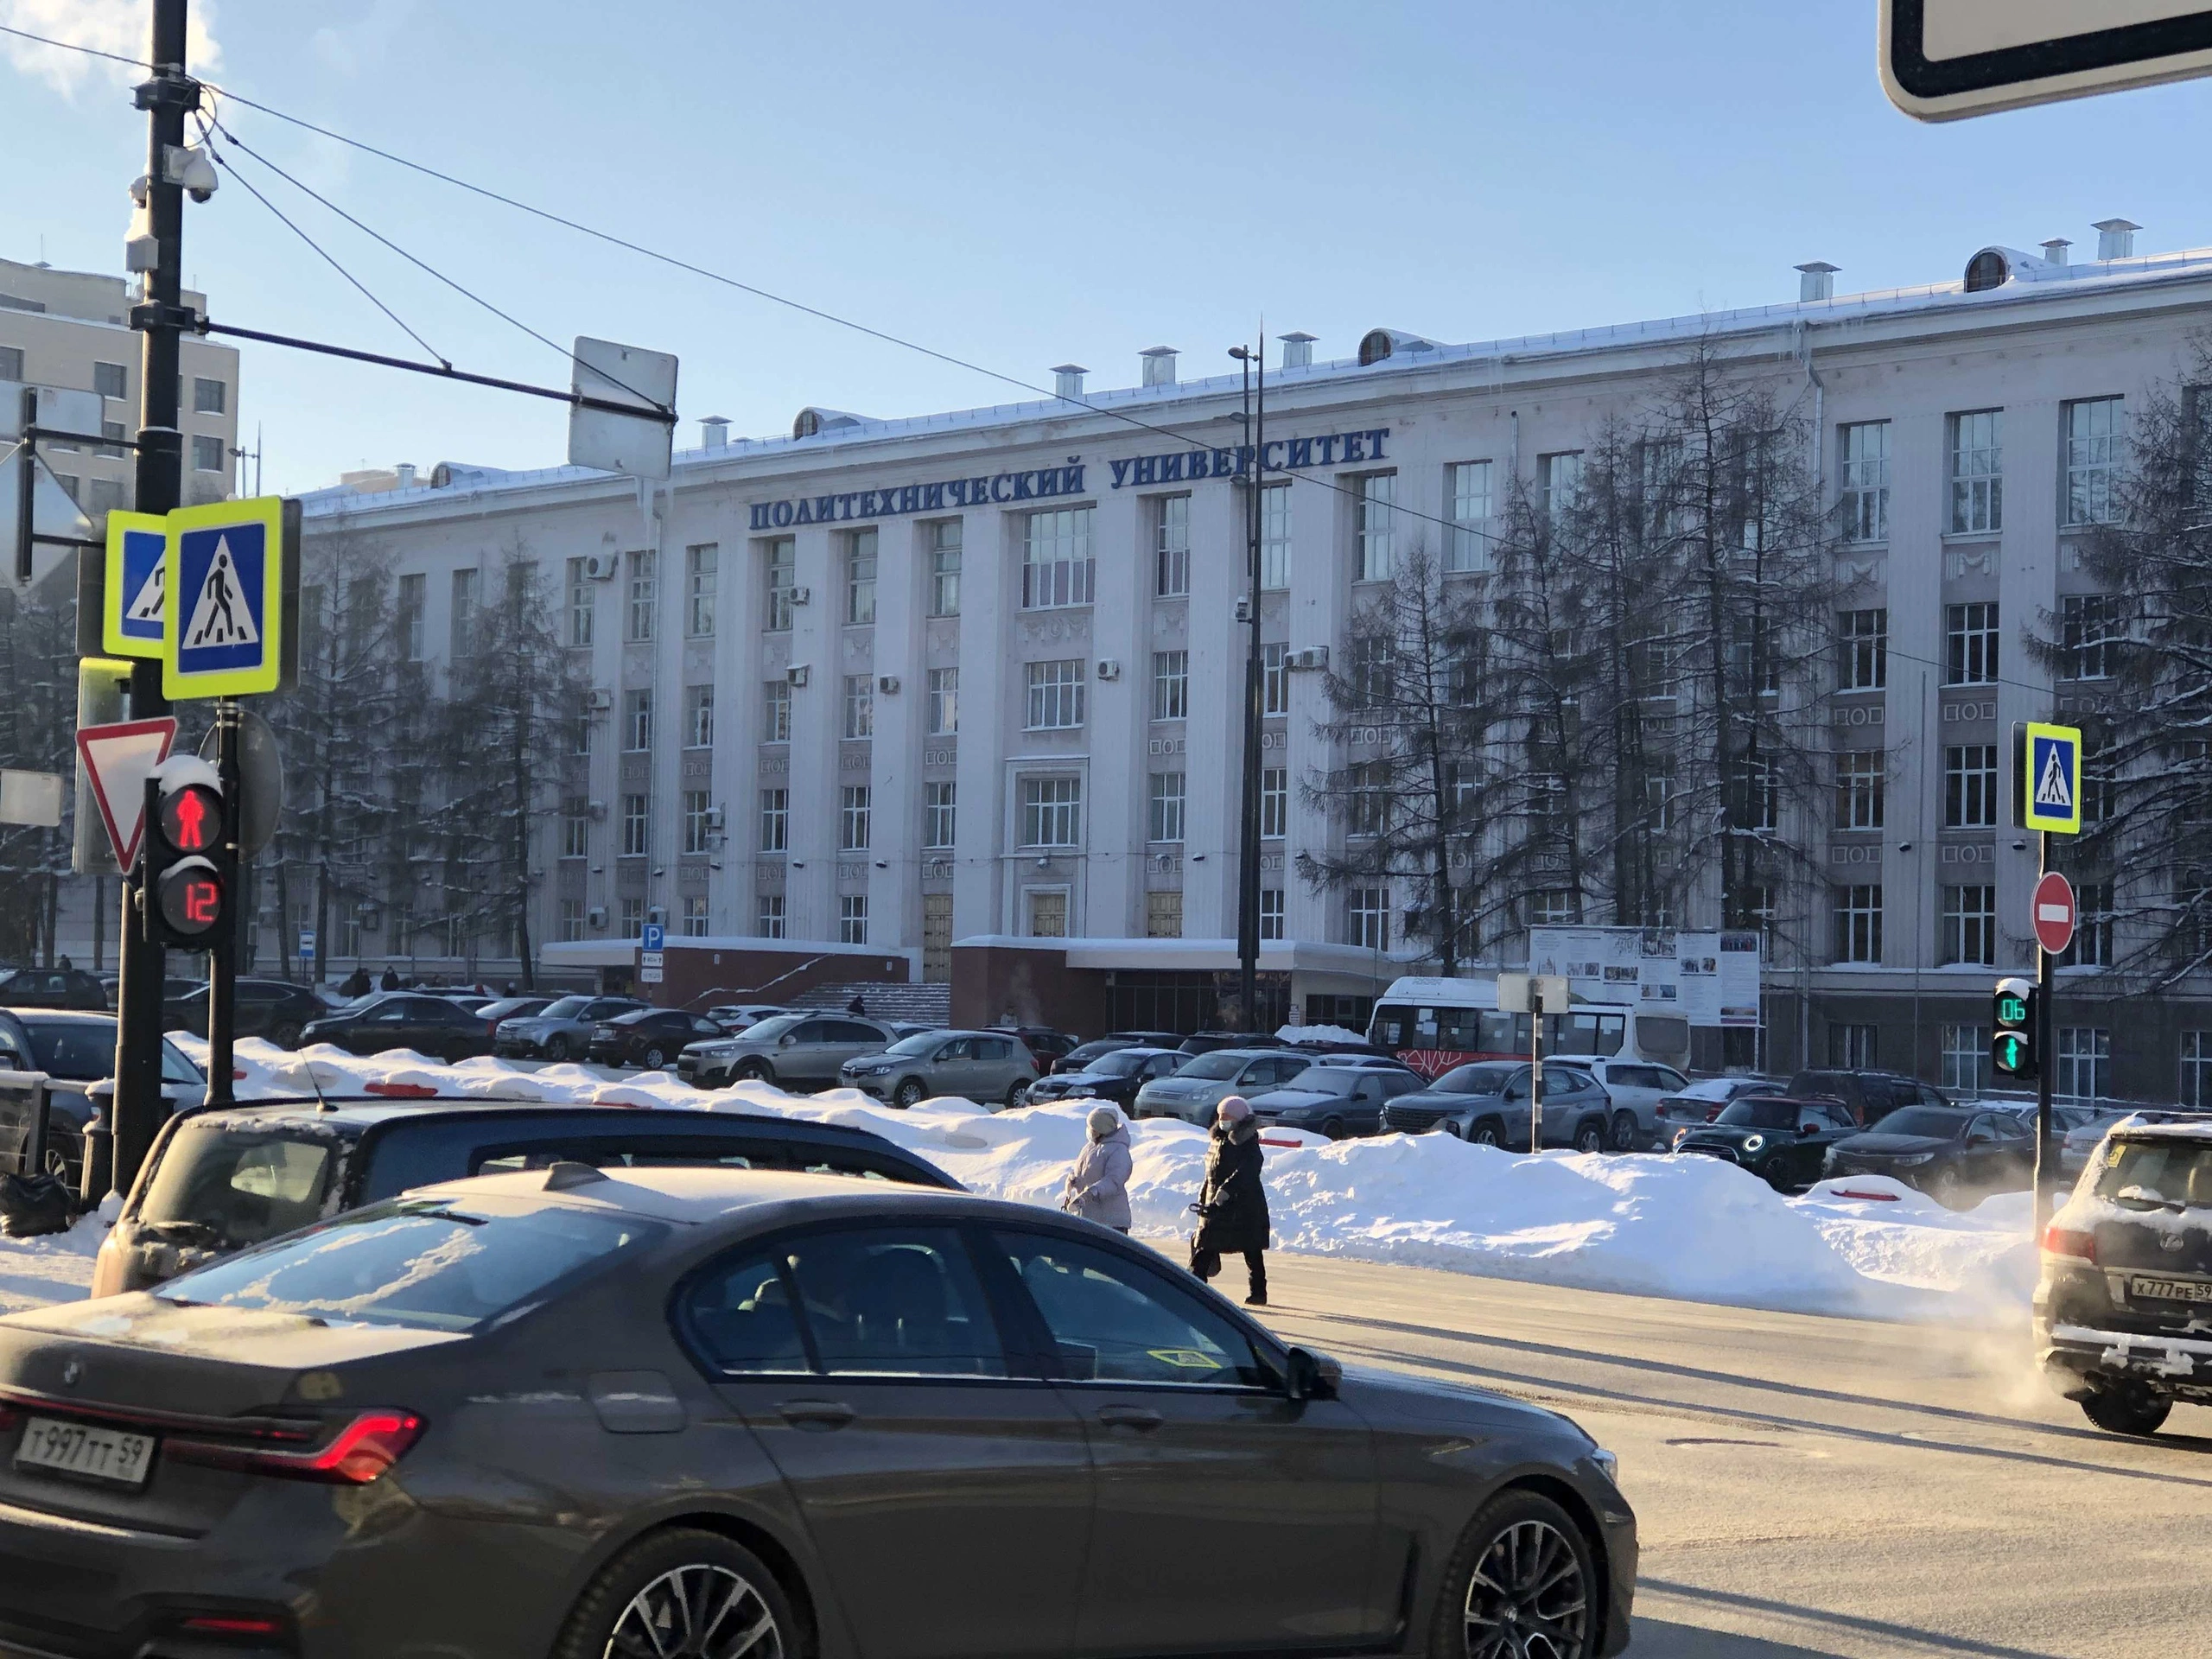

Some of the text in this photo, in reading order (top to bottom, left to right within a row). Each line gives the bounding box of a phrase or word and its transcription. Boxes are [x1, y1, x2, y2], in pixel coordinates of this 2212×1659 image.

[749, 428, 1389, 531] ПОЛИТЕХНИЧЕСКИЙ УНИВЕРСИТЕТ
[186, 882, 218, 922] 12
[648, 927, 660, 948] P
[2002, 999, 2025, 1020] 06
